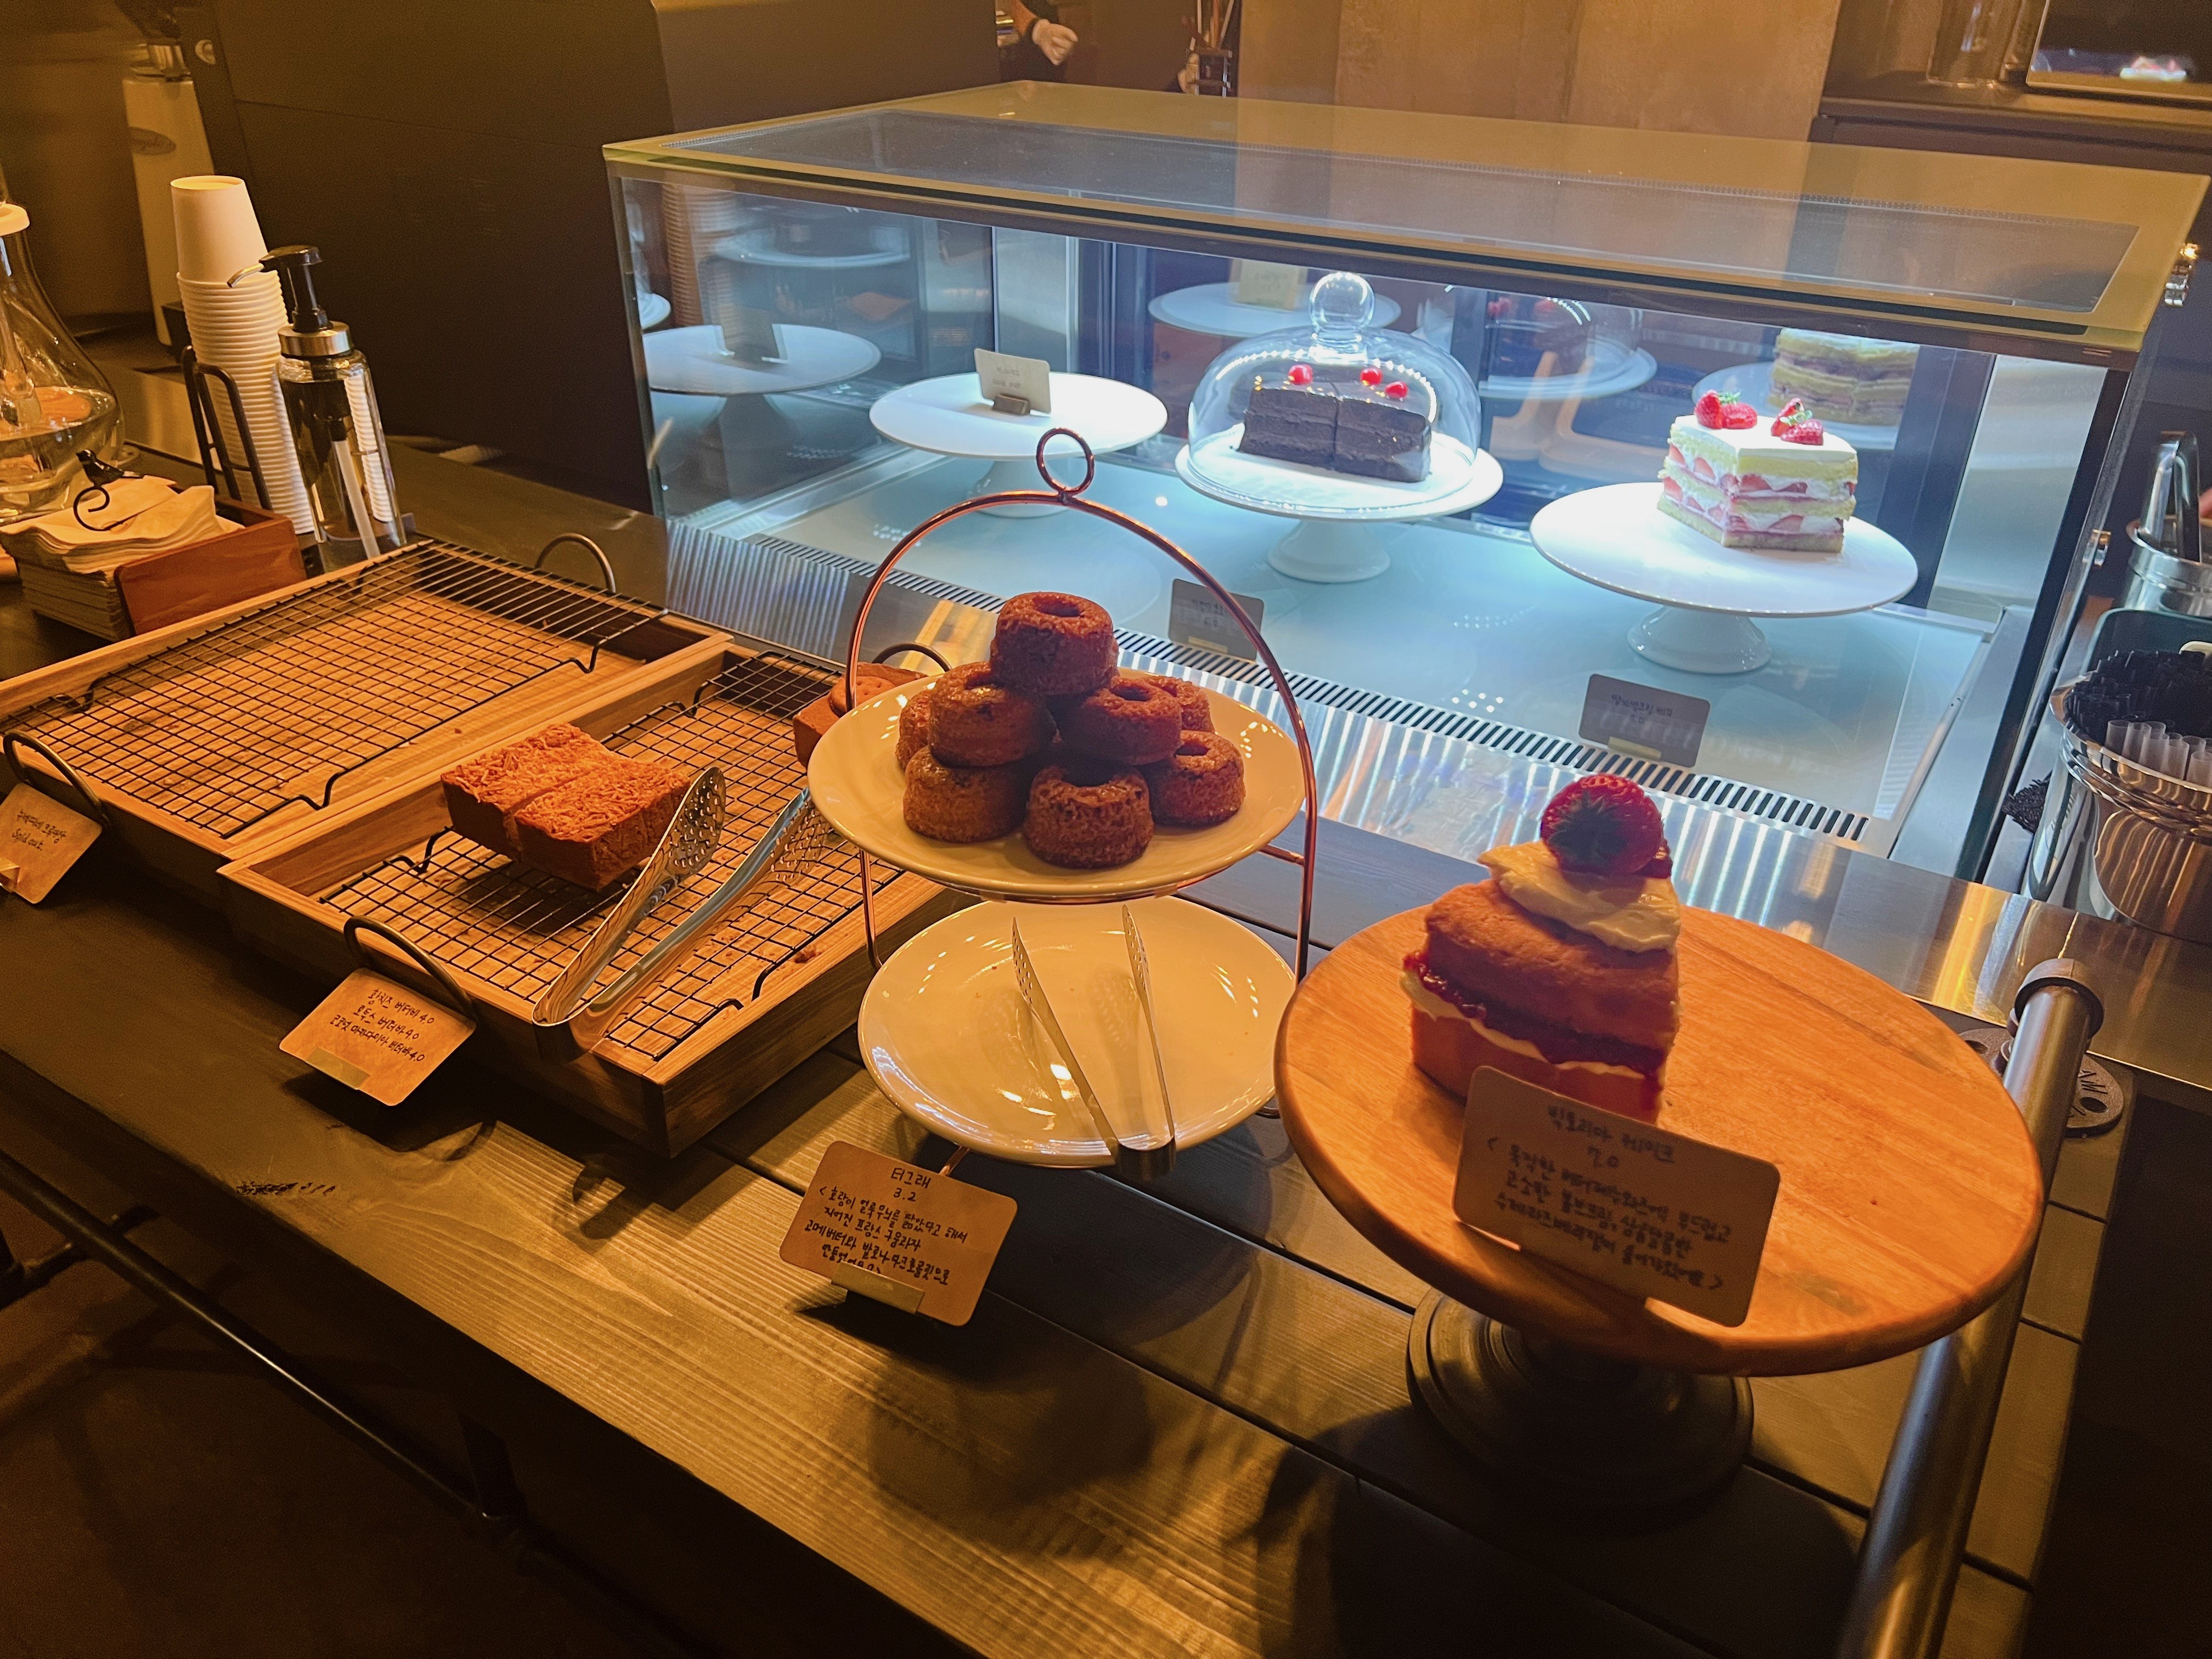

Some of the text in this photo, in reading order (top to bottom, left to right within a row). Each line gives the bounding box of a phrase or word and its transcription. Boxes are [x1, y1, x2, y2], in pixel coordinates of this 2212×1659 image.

[353, 1005, 376, 1024] 로투스
[394, 1000, 421, 1018] 버터바
[893, 1187, 917, 1202] 3.2
[824, 1206, 853, 1227] 지어진
[855, 1218, 882, 1239] 프랑스
[828, 1186, 856, 1209] 호랑이
[944, 1227, 968, 1244] 해서
